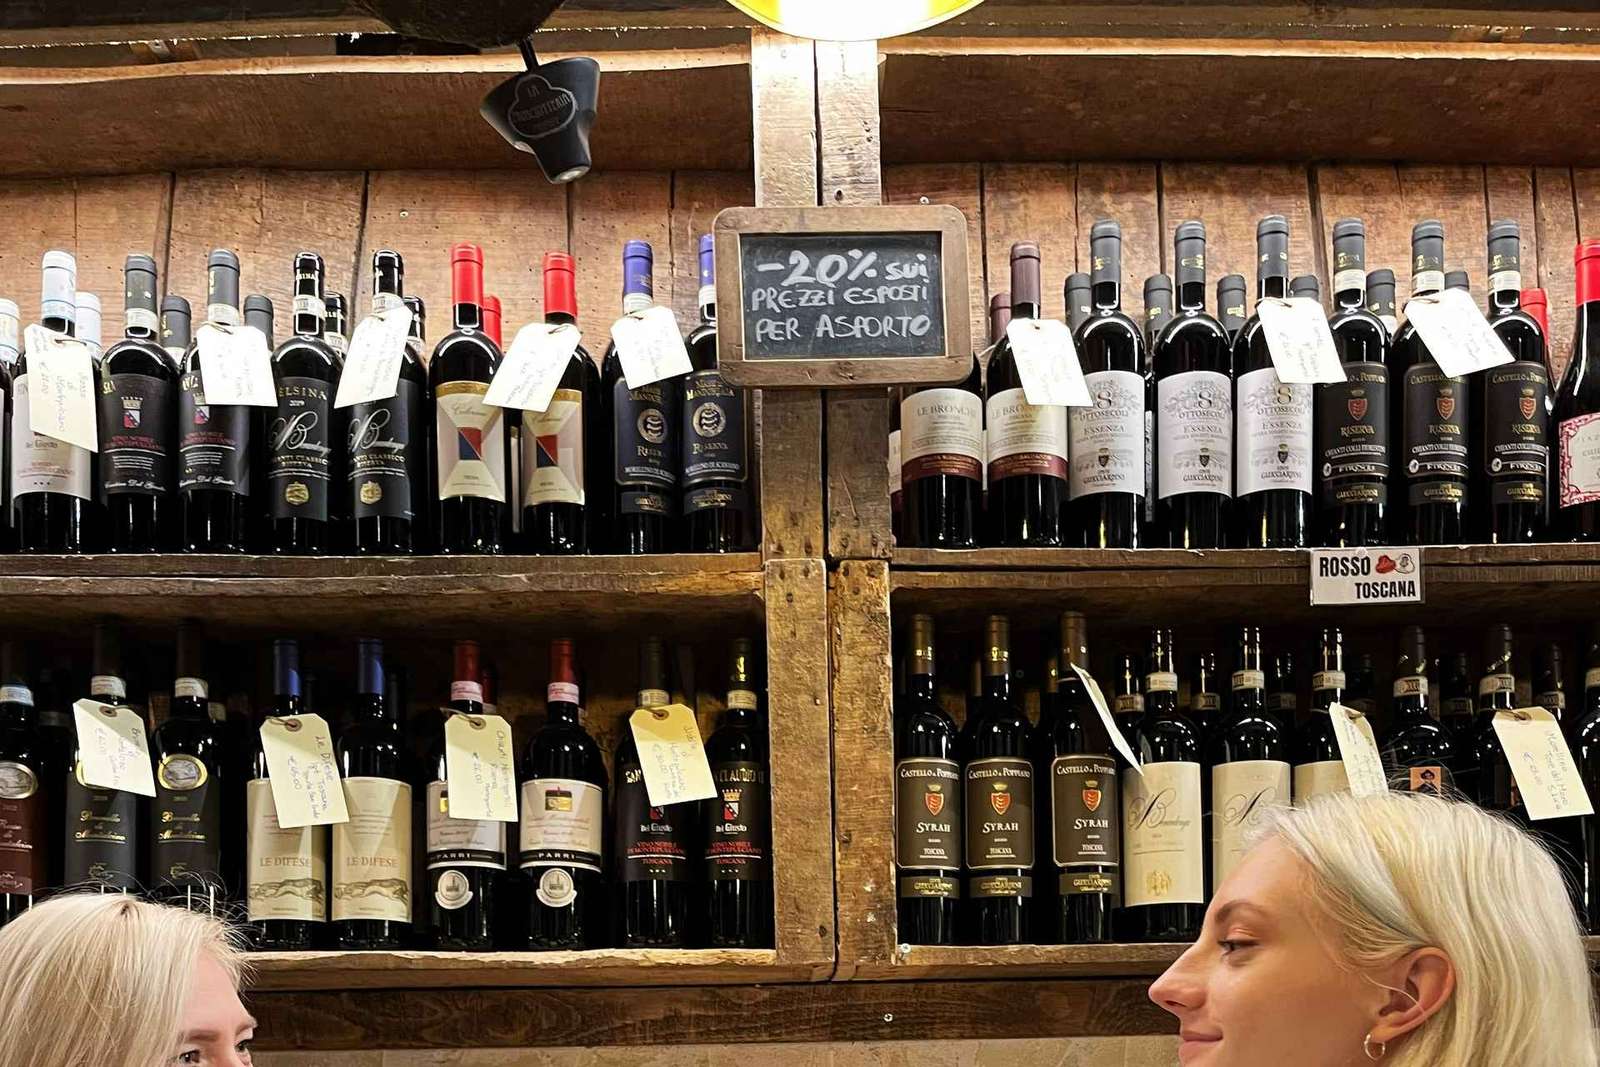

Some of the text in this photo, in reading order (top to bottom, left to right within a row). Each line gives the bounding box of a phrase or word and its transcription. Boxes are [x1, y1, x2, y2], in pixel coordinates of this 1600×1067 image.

[752, 284, 928, 313] PREZZI ESPOSTI
[756, 314, 930, 342] PER ASPORTO
[1320, 556, 1371, 577] ROSSO
[1355, 580, 1416, 599] TOSCANA
[901, 768, 932, 778] CASTELLO
[968, 769, 998, 779] CASTELLO
[1056, 764, 1089, 775] CASTELLO
[916, 822, 951, 833] SYRAH
[982, 822, 1019, 834] SYRAH
[1074, 818, 1109, 830] SYRAH
[260, 857, 271, 867] LE
[347, 856, 398, 868] LE DIFESE
